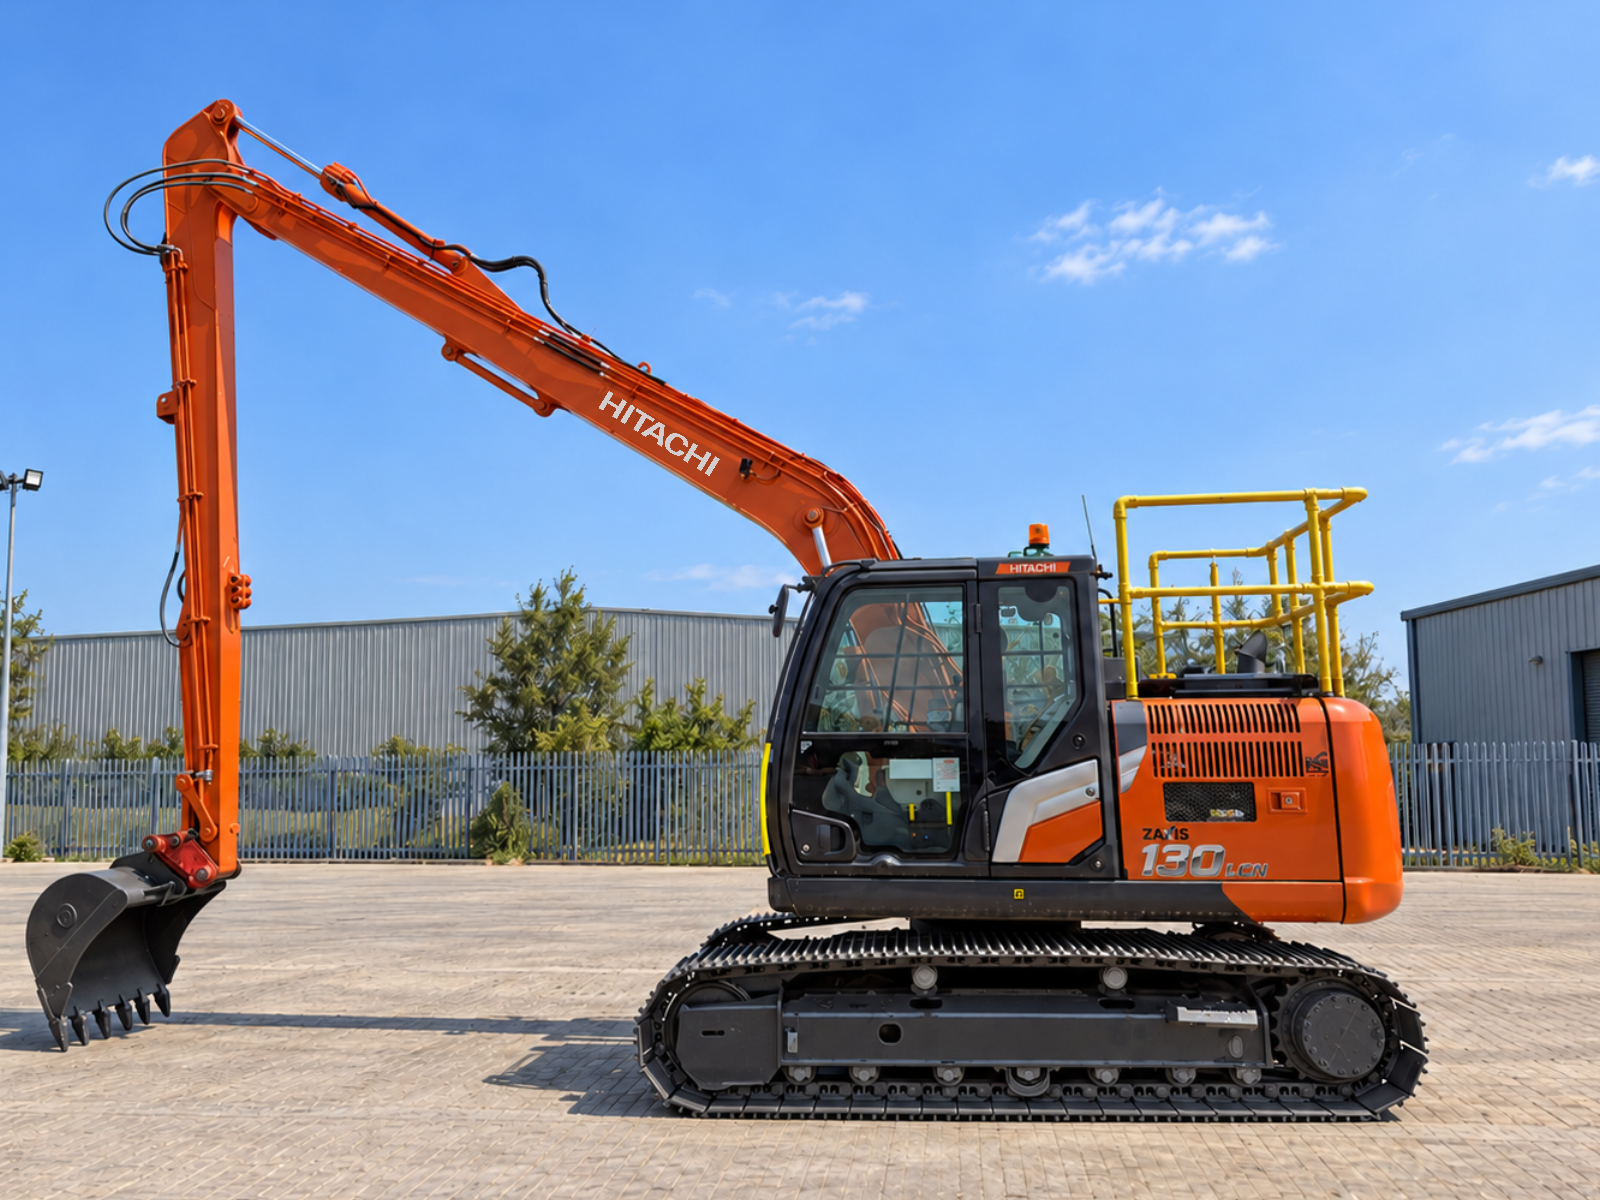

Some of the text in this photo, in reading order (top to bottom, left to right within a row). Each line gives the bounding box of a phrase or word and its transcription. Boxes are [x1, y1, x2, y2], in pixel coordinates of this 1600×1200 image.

[599, 391, 720, 476] HITACHI
[1009, 563, 1056, 573] HITACHI
[1141, 843, 1226, 877] 130
